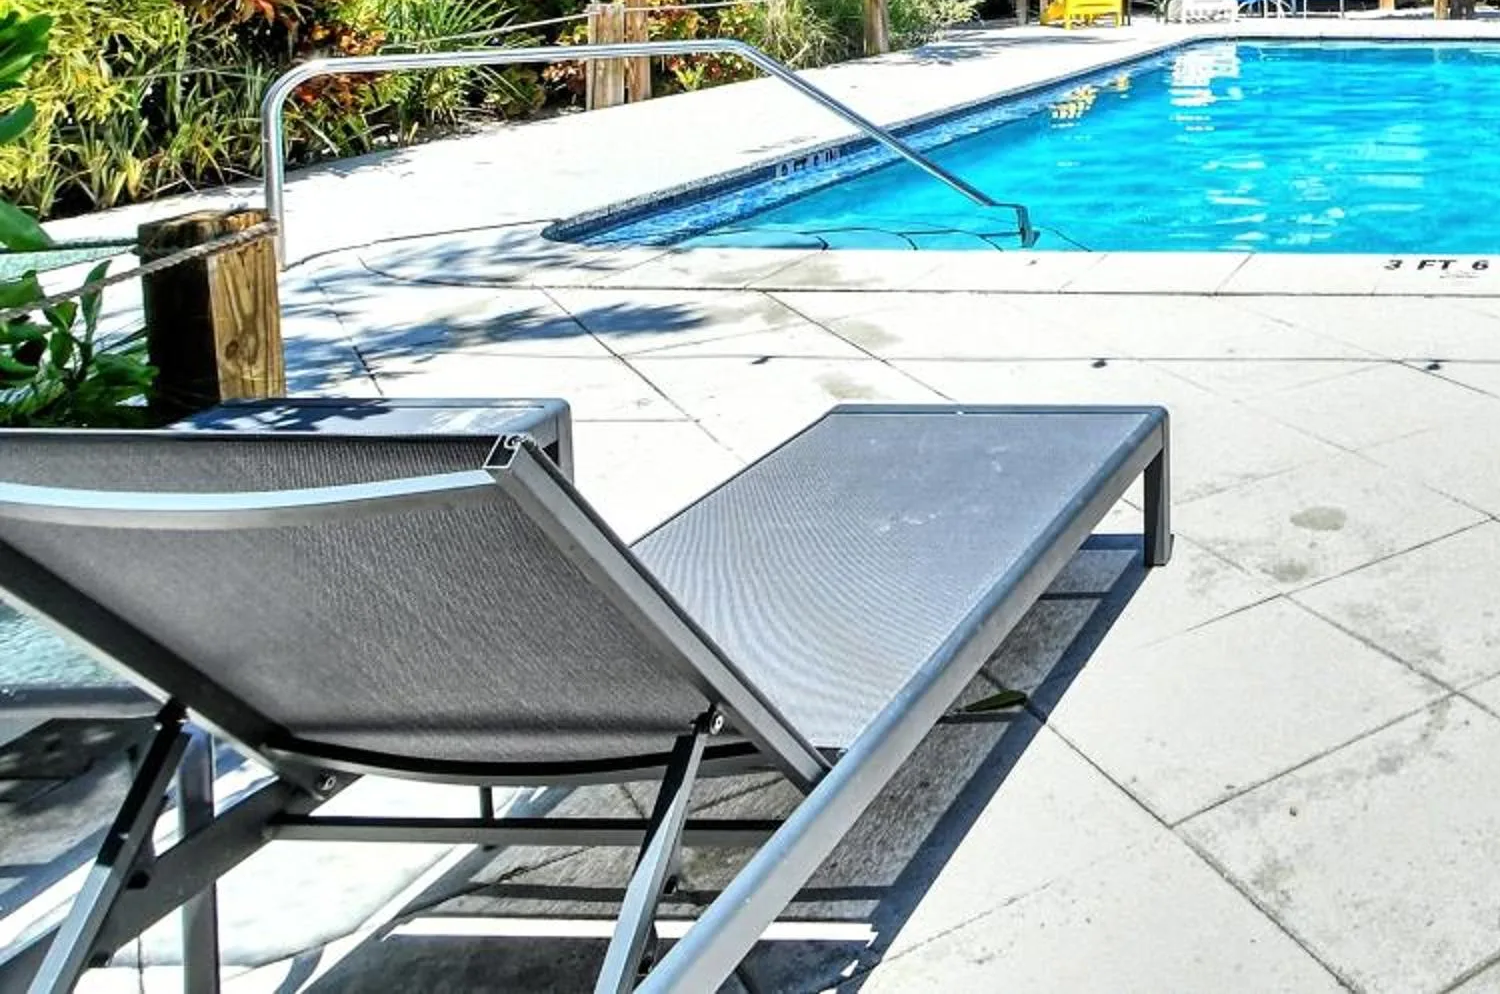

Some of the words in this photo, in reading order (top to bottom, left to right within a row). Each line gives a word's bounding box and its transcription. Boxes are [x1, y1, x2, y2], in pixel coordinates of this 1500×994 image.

[1383, 259, 1403, 271] 3
[1416, 259, 1459, 271] FT
[1471, 259, 1490, 271] 6
